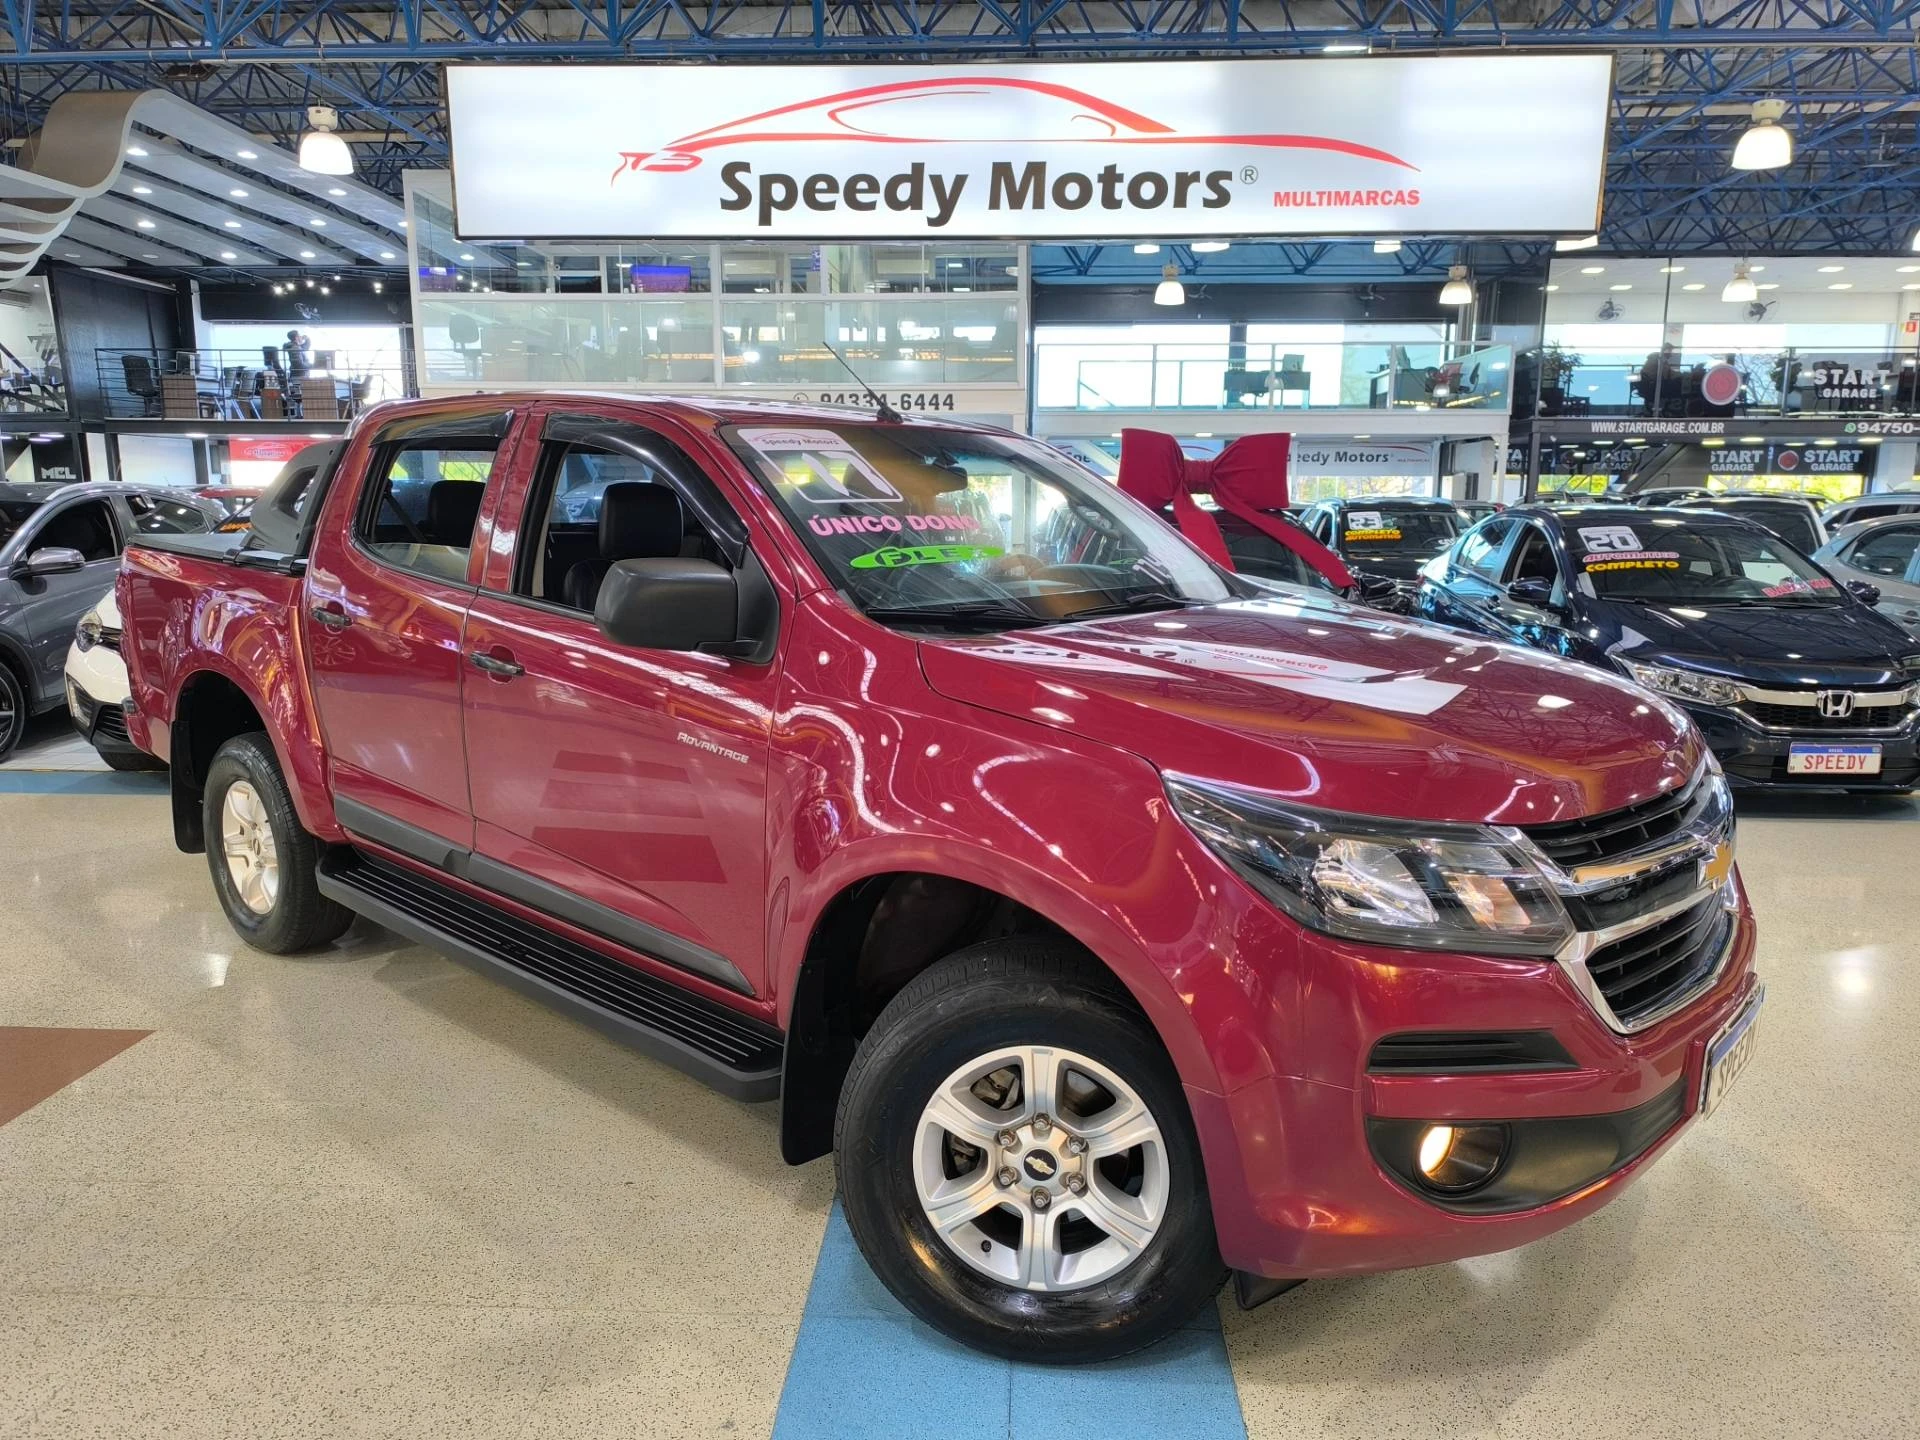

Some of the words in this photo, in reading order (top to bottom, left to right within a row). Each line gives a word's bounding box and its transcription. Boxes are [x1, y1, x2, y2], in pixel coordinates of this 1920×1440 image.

[720, 162, 969, 228] Speedy
[988, 161, 1233, 210] Motors
[1273, 189, 1420, 208] MULTIMARCAS
[1814, 369, 1890, 385] START
[1822, 388, 1877, 398] GARAGE
[1591, 422, 1725, 433] WWW.STARTGARAGE.COM.BR
[1334, 451, 1389, 462] Motors
[1804, 450, 1863, 463] START
[1712, 464, 1755, 472] GARAGE
[1811, 464, 1853, 472] GARAGE
[808, 514, 903, 537] ÚNICO
[905, 514, 981, 531] DONO
[1583, 534, 1639, 550] 20
[1586, 561, 1680, 573] COMPLETO
[677, 732, 749, 764] ADVANTAGE
[1803, 755, 1867, 770] SPEEDY
